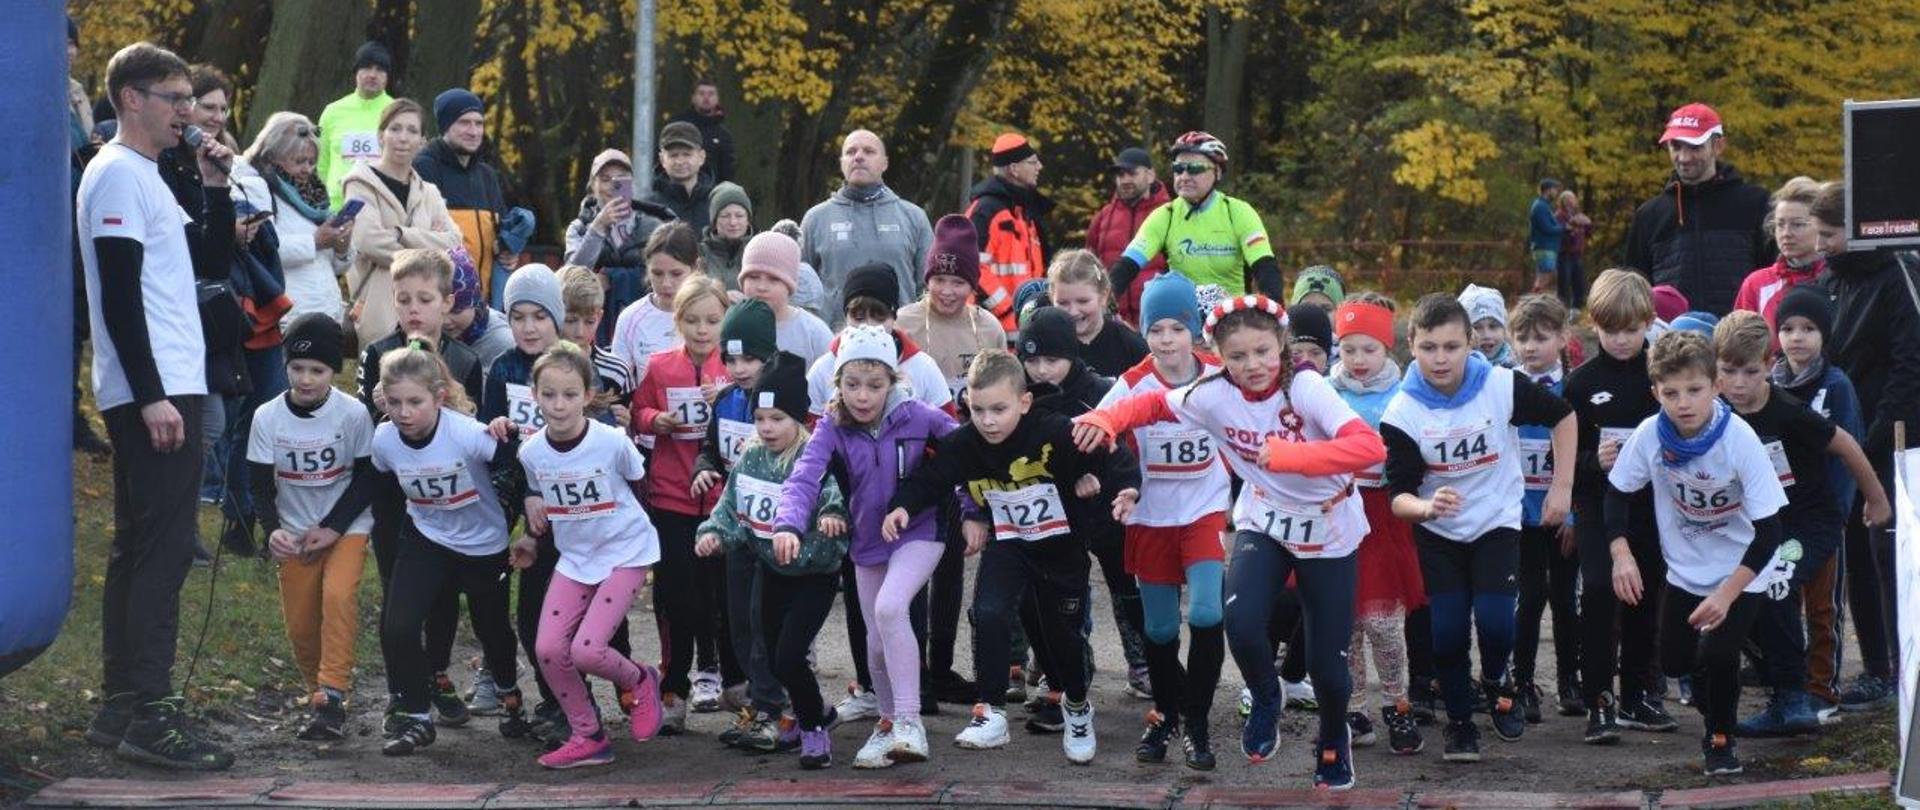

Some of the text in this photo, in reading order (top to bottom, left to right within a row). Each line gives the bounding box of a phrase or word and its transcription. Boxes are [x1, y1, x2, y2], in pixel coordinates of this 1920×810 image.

[352, 140, 371, 153] 86
[286, 447, 336, 472] 159
[1161, 436, 1209, 463] 185
[1434, 433, 1488, 463] 144
[411, 473, 458, 499] 157
[551, 480, 600, 505] 154
[1677, 483, 1728, 508] 136
[1001, 498, 1053, 526] 122
[1265, 511, 1313, 543] 111
